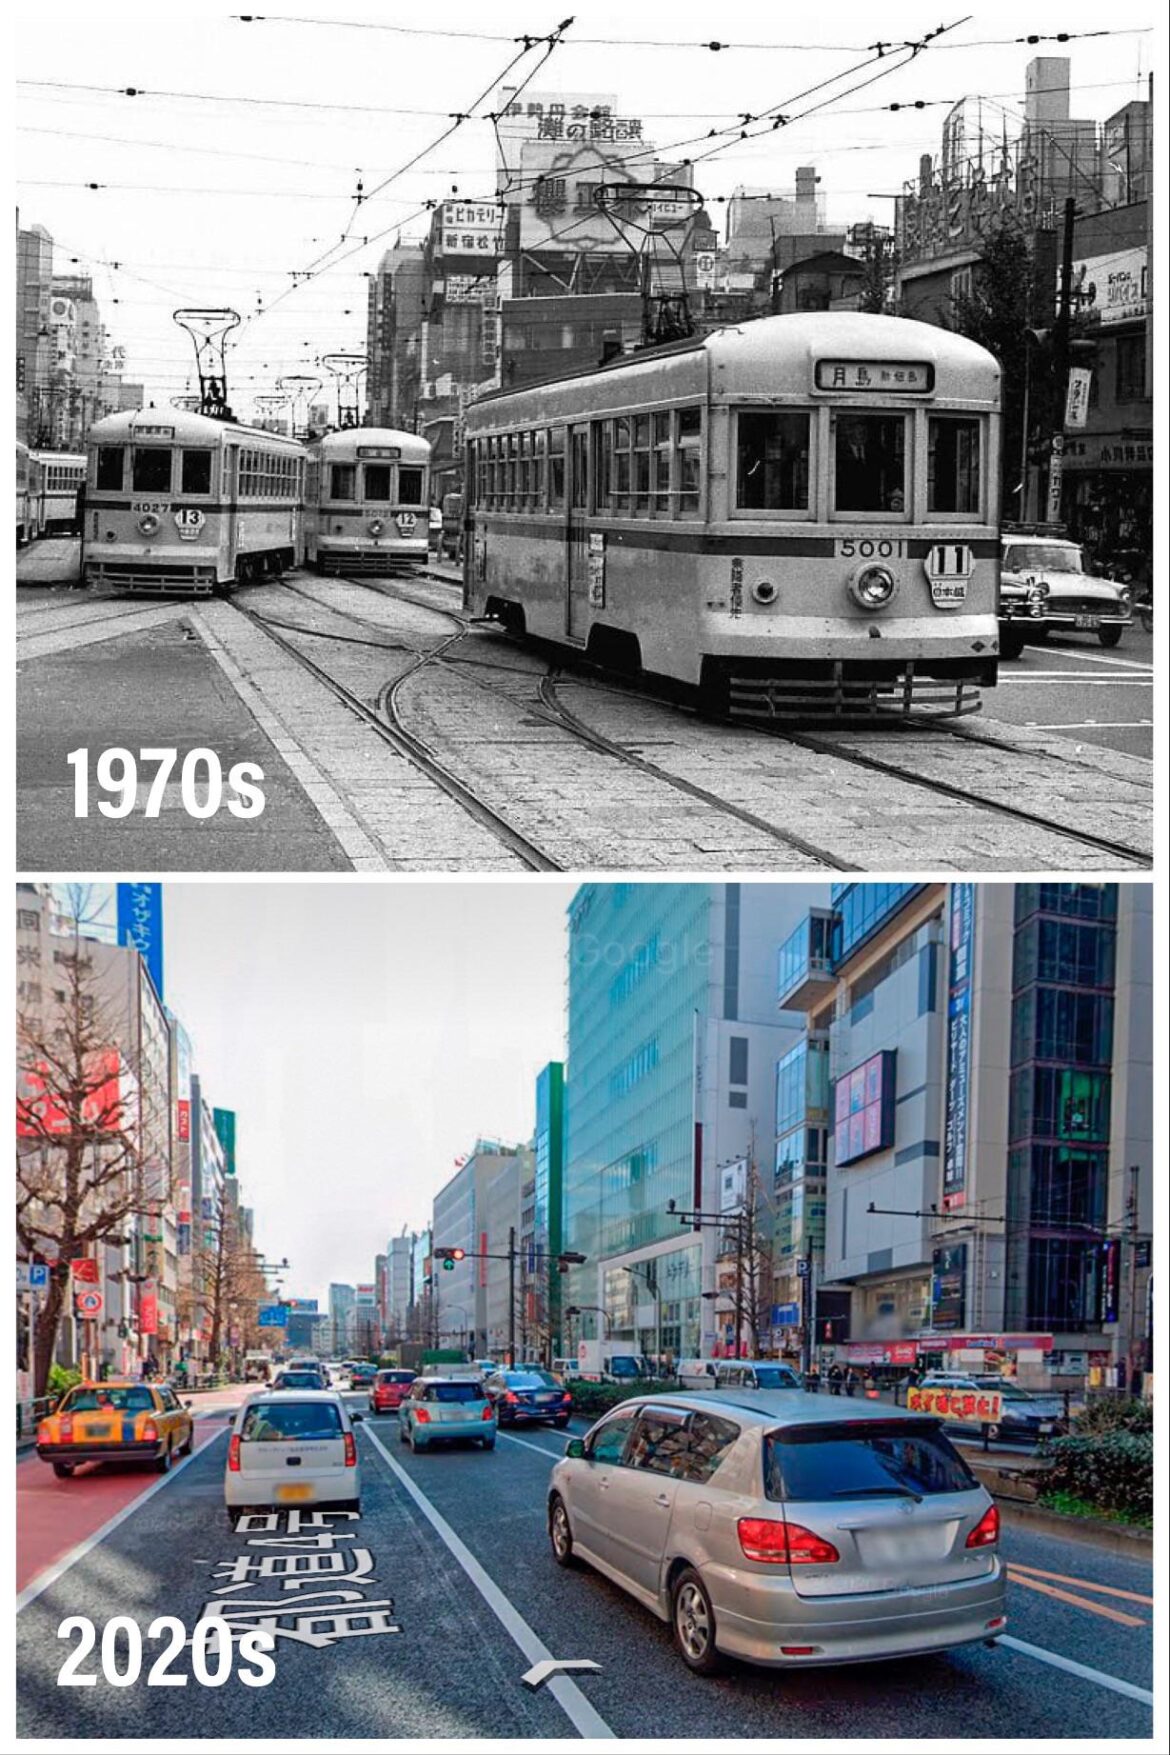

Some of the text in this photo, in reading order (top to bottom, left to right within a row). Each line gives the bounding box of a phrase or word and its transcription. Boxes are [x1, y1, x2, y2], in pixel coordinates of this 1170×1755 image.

[133, 503, 170, 513] 4027
[181, 510, 200, 525] 13
[401, 513, 415, 525] 12
[840, 540, 903, 558] 5001
[938, 546, 964, 574] 11
[33, 1268, 45, 1281] P
